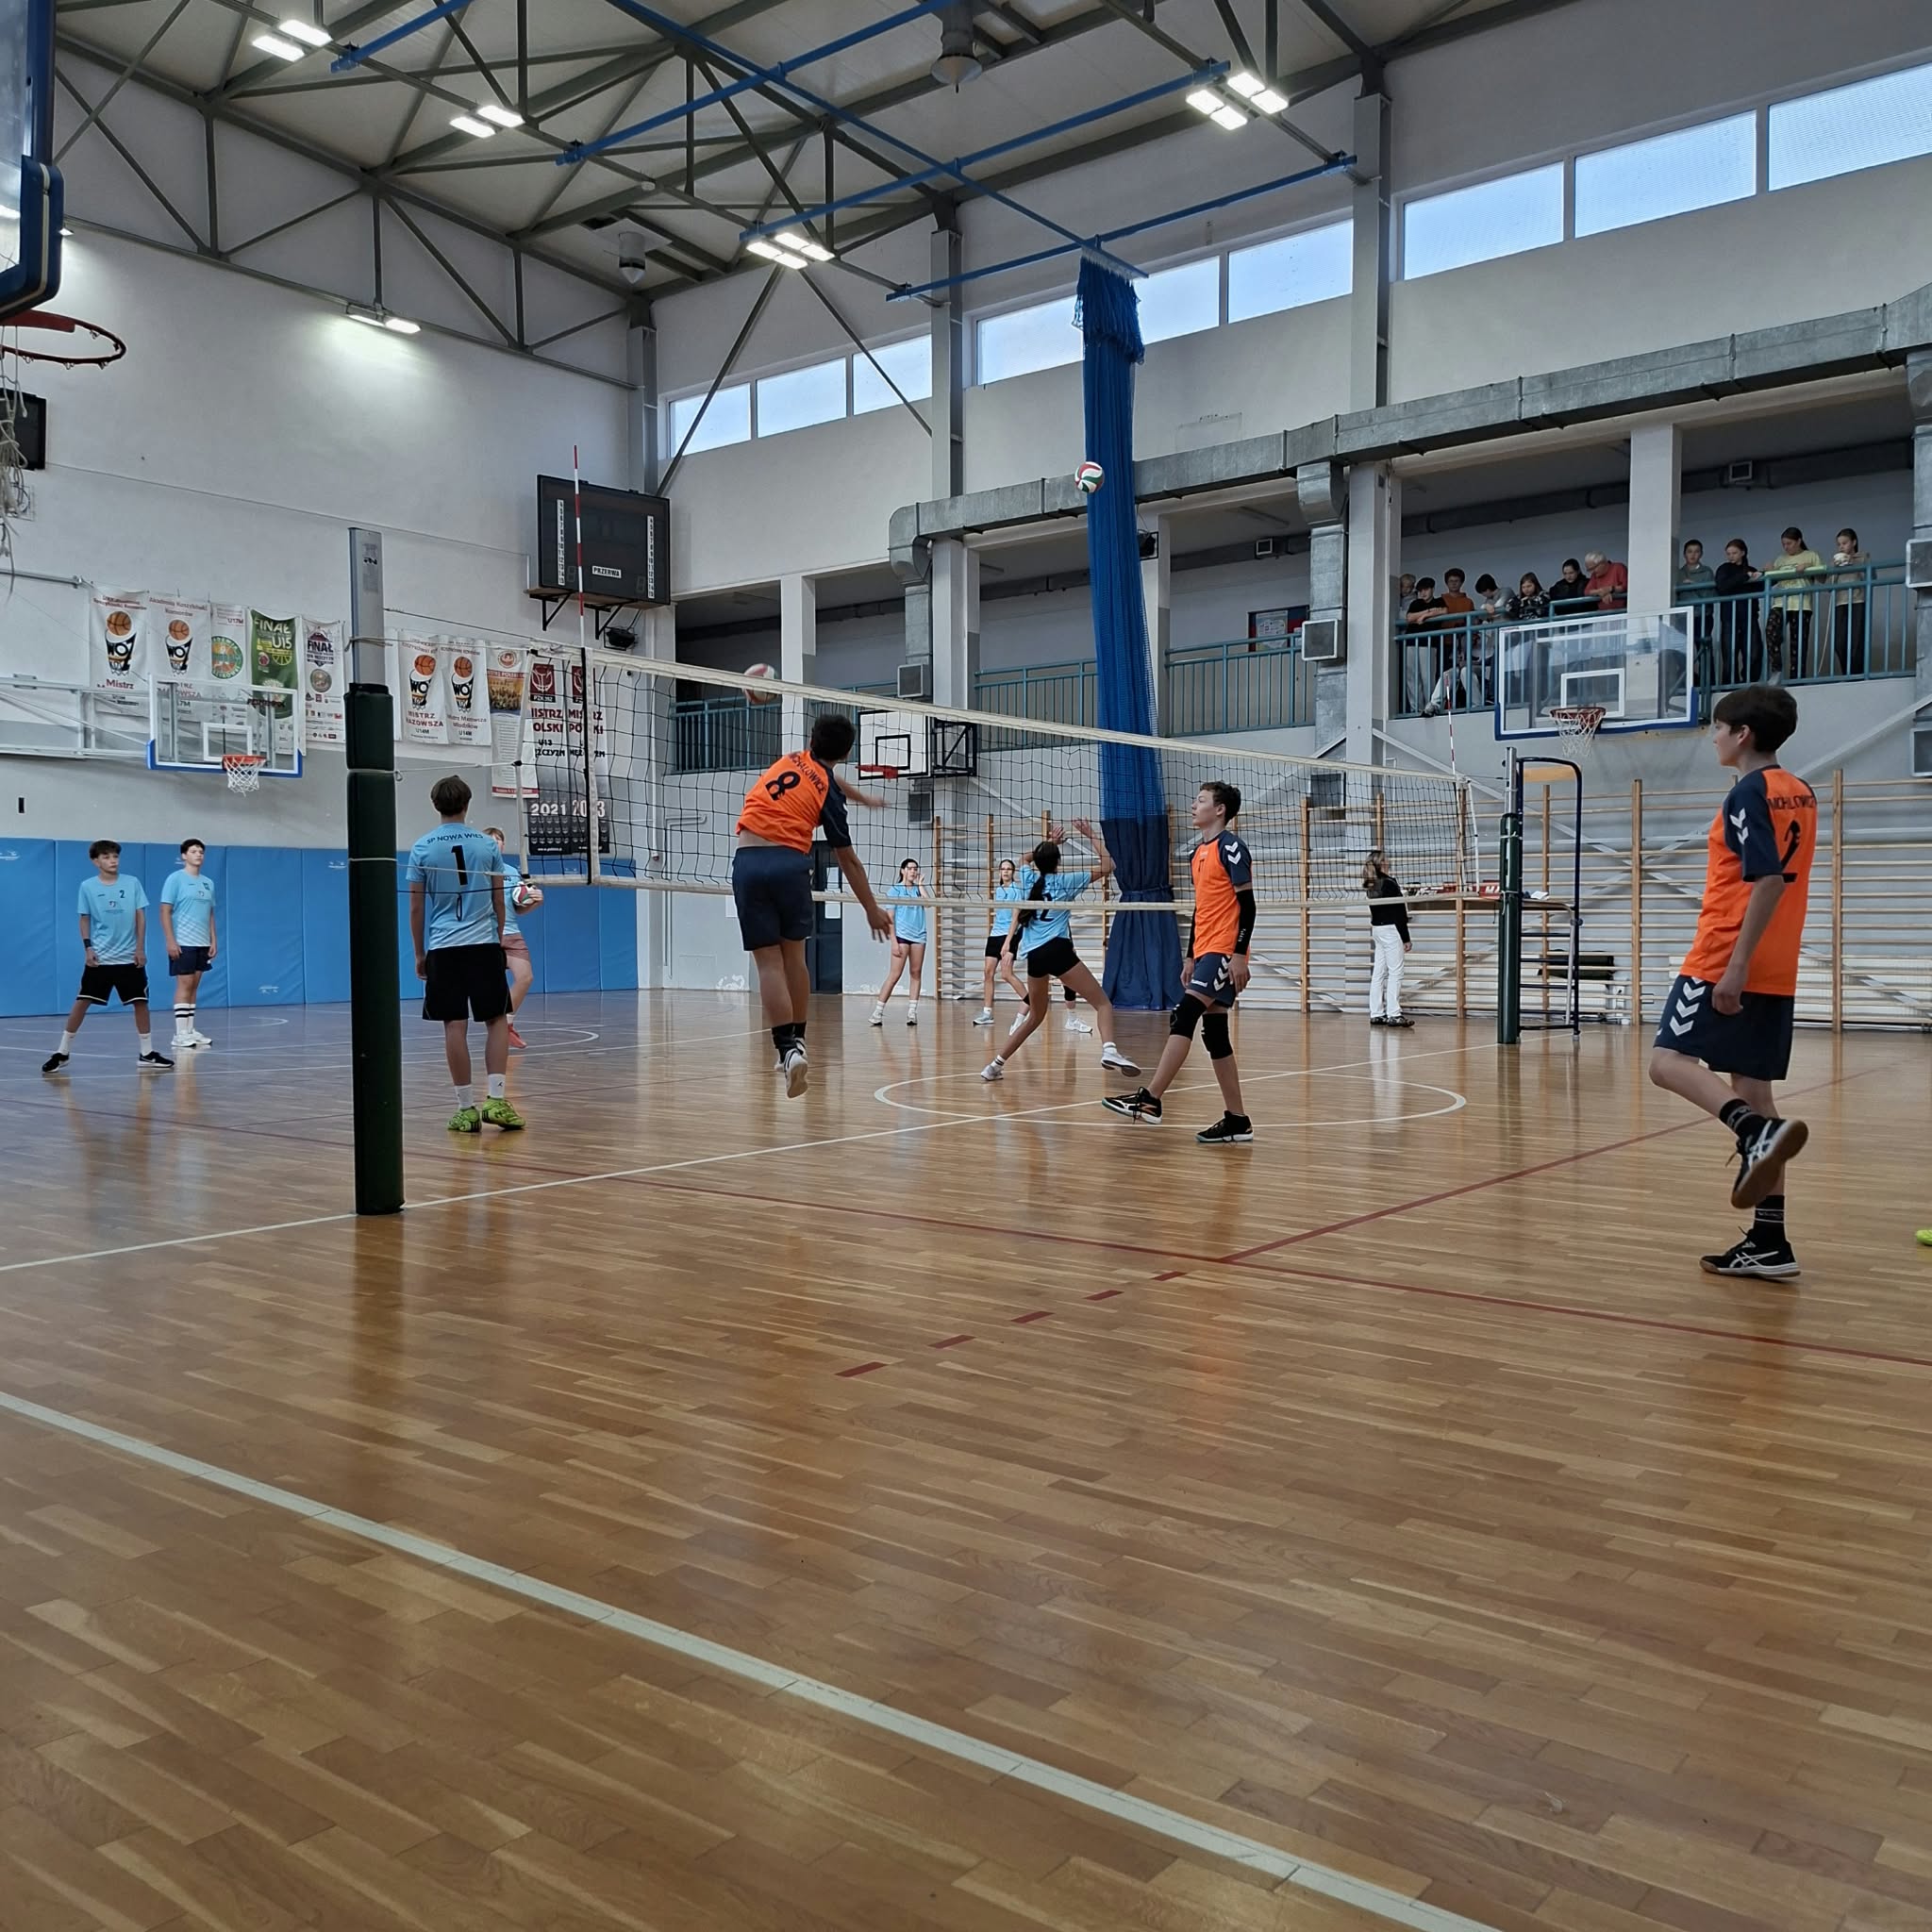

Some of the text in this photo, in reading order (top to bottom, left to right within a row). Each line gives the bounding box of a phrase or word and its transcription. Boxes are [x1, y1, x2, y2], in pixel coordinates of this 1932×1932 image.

[593, 567, 620, 576] PRZERWA
[255, 619, 291, 634] FINAŁ
[272, 635, 292, 649] U15
[106, 679, 134, 690] Mistrz
[533, 723, 563, 733] OLSKI
[569, 724, 604, 734] POKI
[765, 771, 801, 801] 8
[530, 803, 567, 816] 2021
[572, 799, 606, 818] 203
[437, 833, 463, 841] NOWA
[1779, 819, 1801, 883] 2
[451, 845, 468, 886] 1
[119, 890, 125, 898] 2
